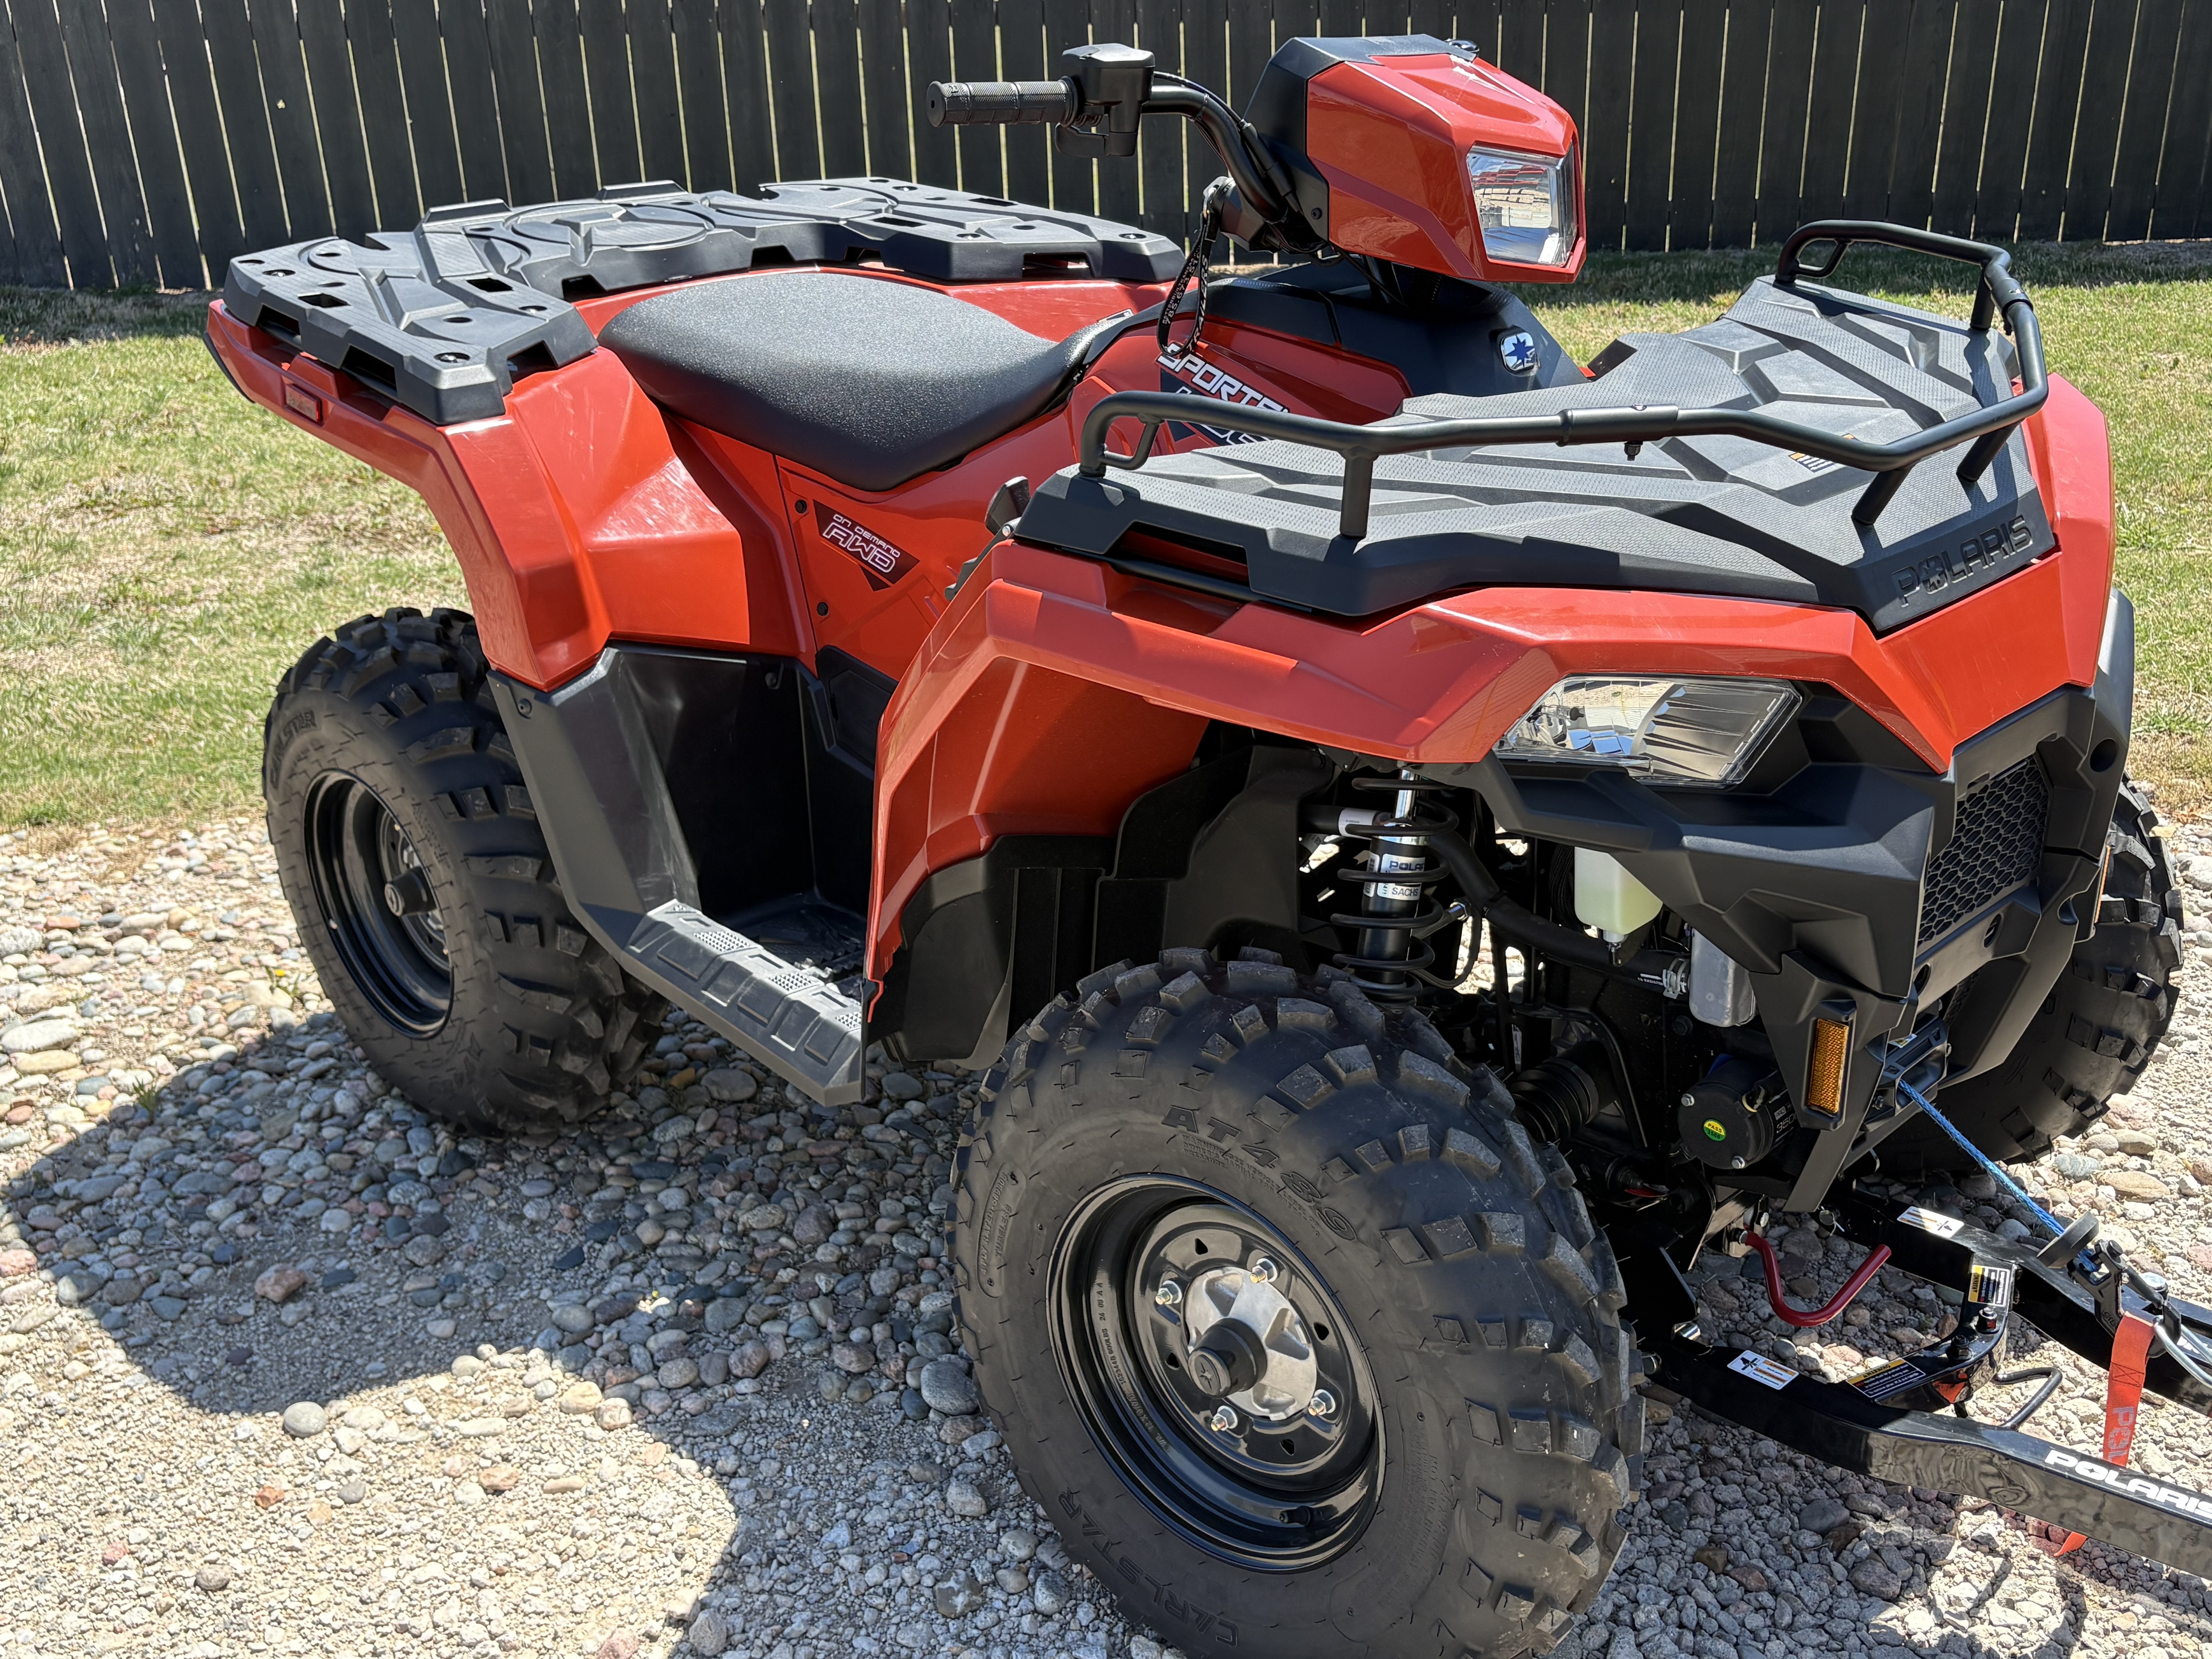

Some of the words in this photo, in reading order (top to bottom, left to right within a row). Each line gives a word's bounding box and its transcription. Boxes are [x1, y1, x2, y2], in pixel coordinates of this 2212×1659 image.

[1186, 254, 1208, 351] TRAILERS
[823, 522, 895, 572] AWD
[833, 514, 852, 527] ON
[855, 526, 900, 558] DEMAND
[1891, 515, 2033, 608] POLARIS
[1392, 887, 1418, 896] SACHS
[1707, 1123, 1723, 1133] PASS
[980, 1245, 989, 1266] PLY
[995, 1204, 1012, 1257] TUBELESS
[1058, 1488, 1238, 1647] CARLSTAR
